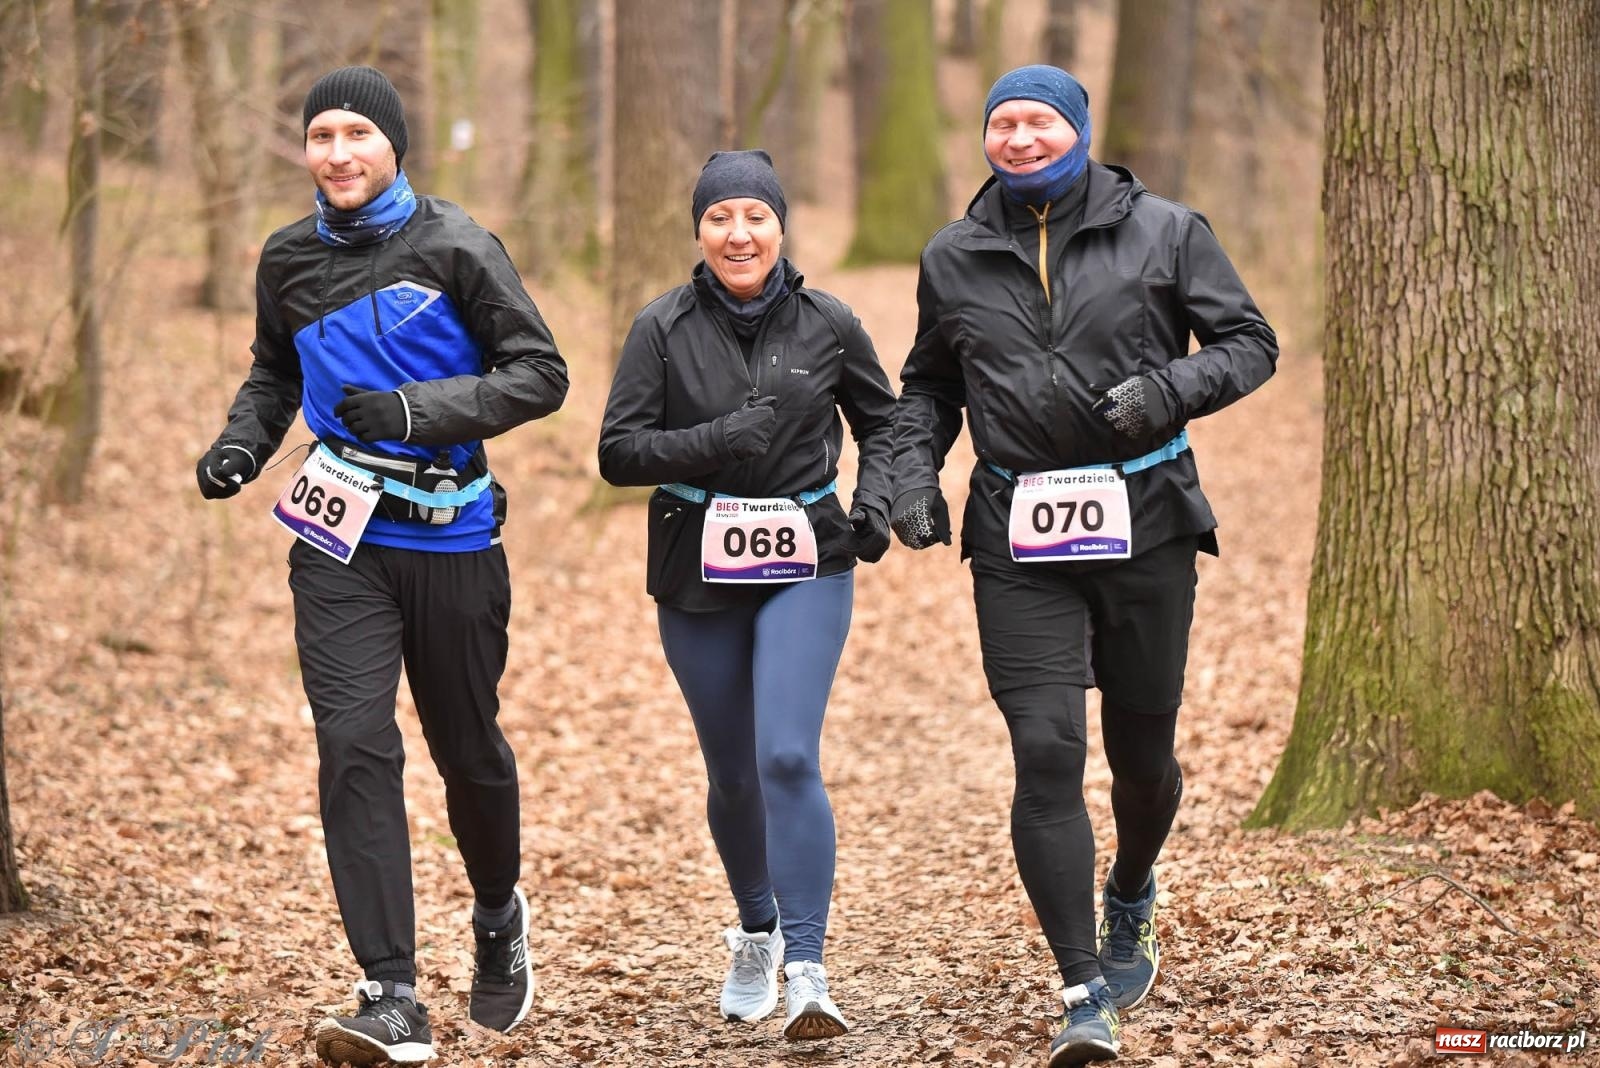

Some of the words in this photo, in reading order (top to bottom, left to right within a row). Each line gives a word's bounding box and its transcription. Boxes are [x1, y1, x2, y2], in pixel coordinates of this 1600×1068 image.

[1023, 477, 1044, 488] BIEG
[1047, 473, 1115, 485] Twardziela
[291, 475, 346, 527] 069
[716, 502, 740, 512] BIEG
[1032, 500, 1105, 534] 070
[723, 527, 797, 558] 068
[1079, 543, 1109, 551] Racibórz
